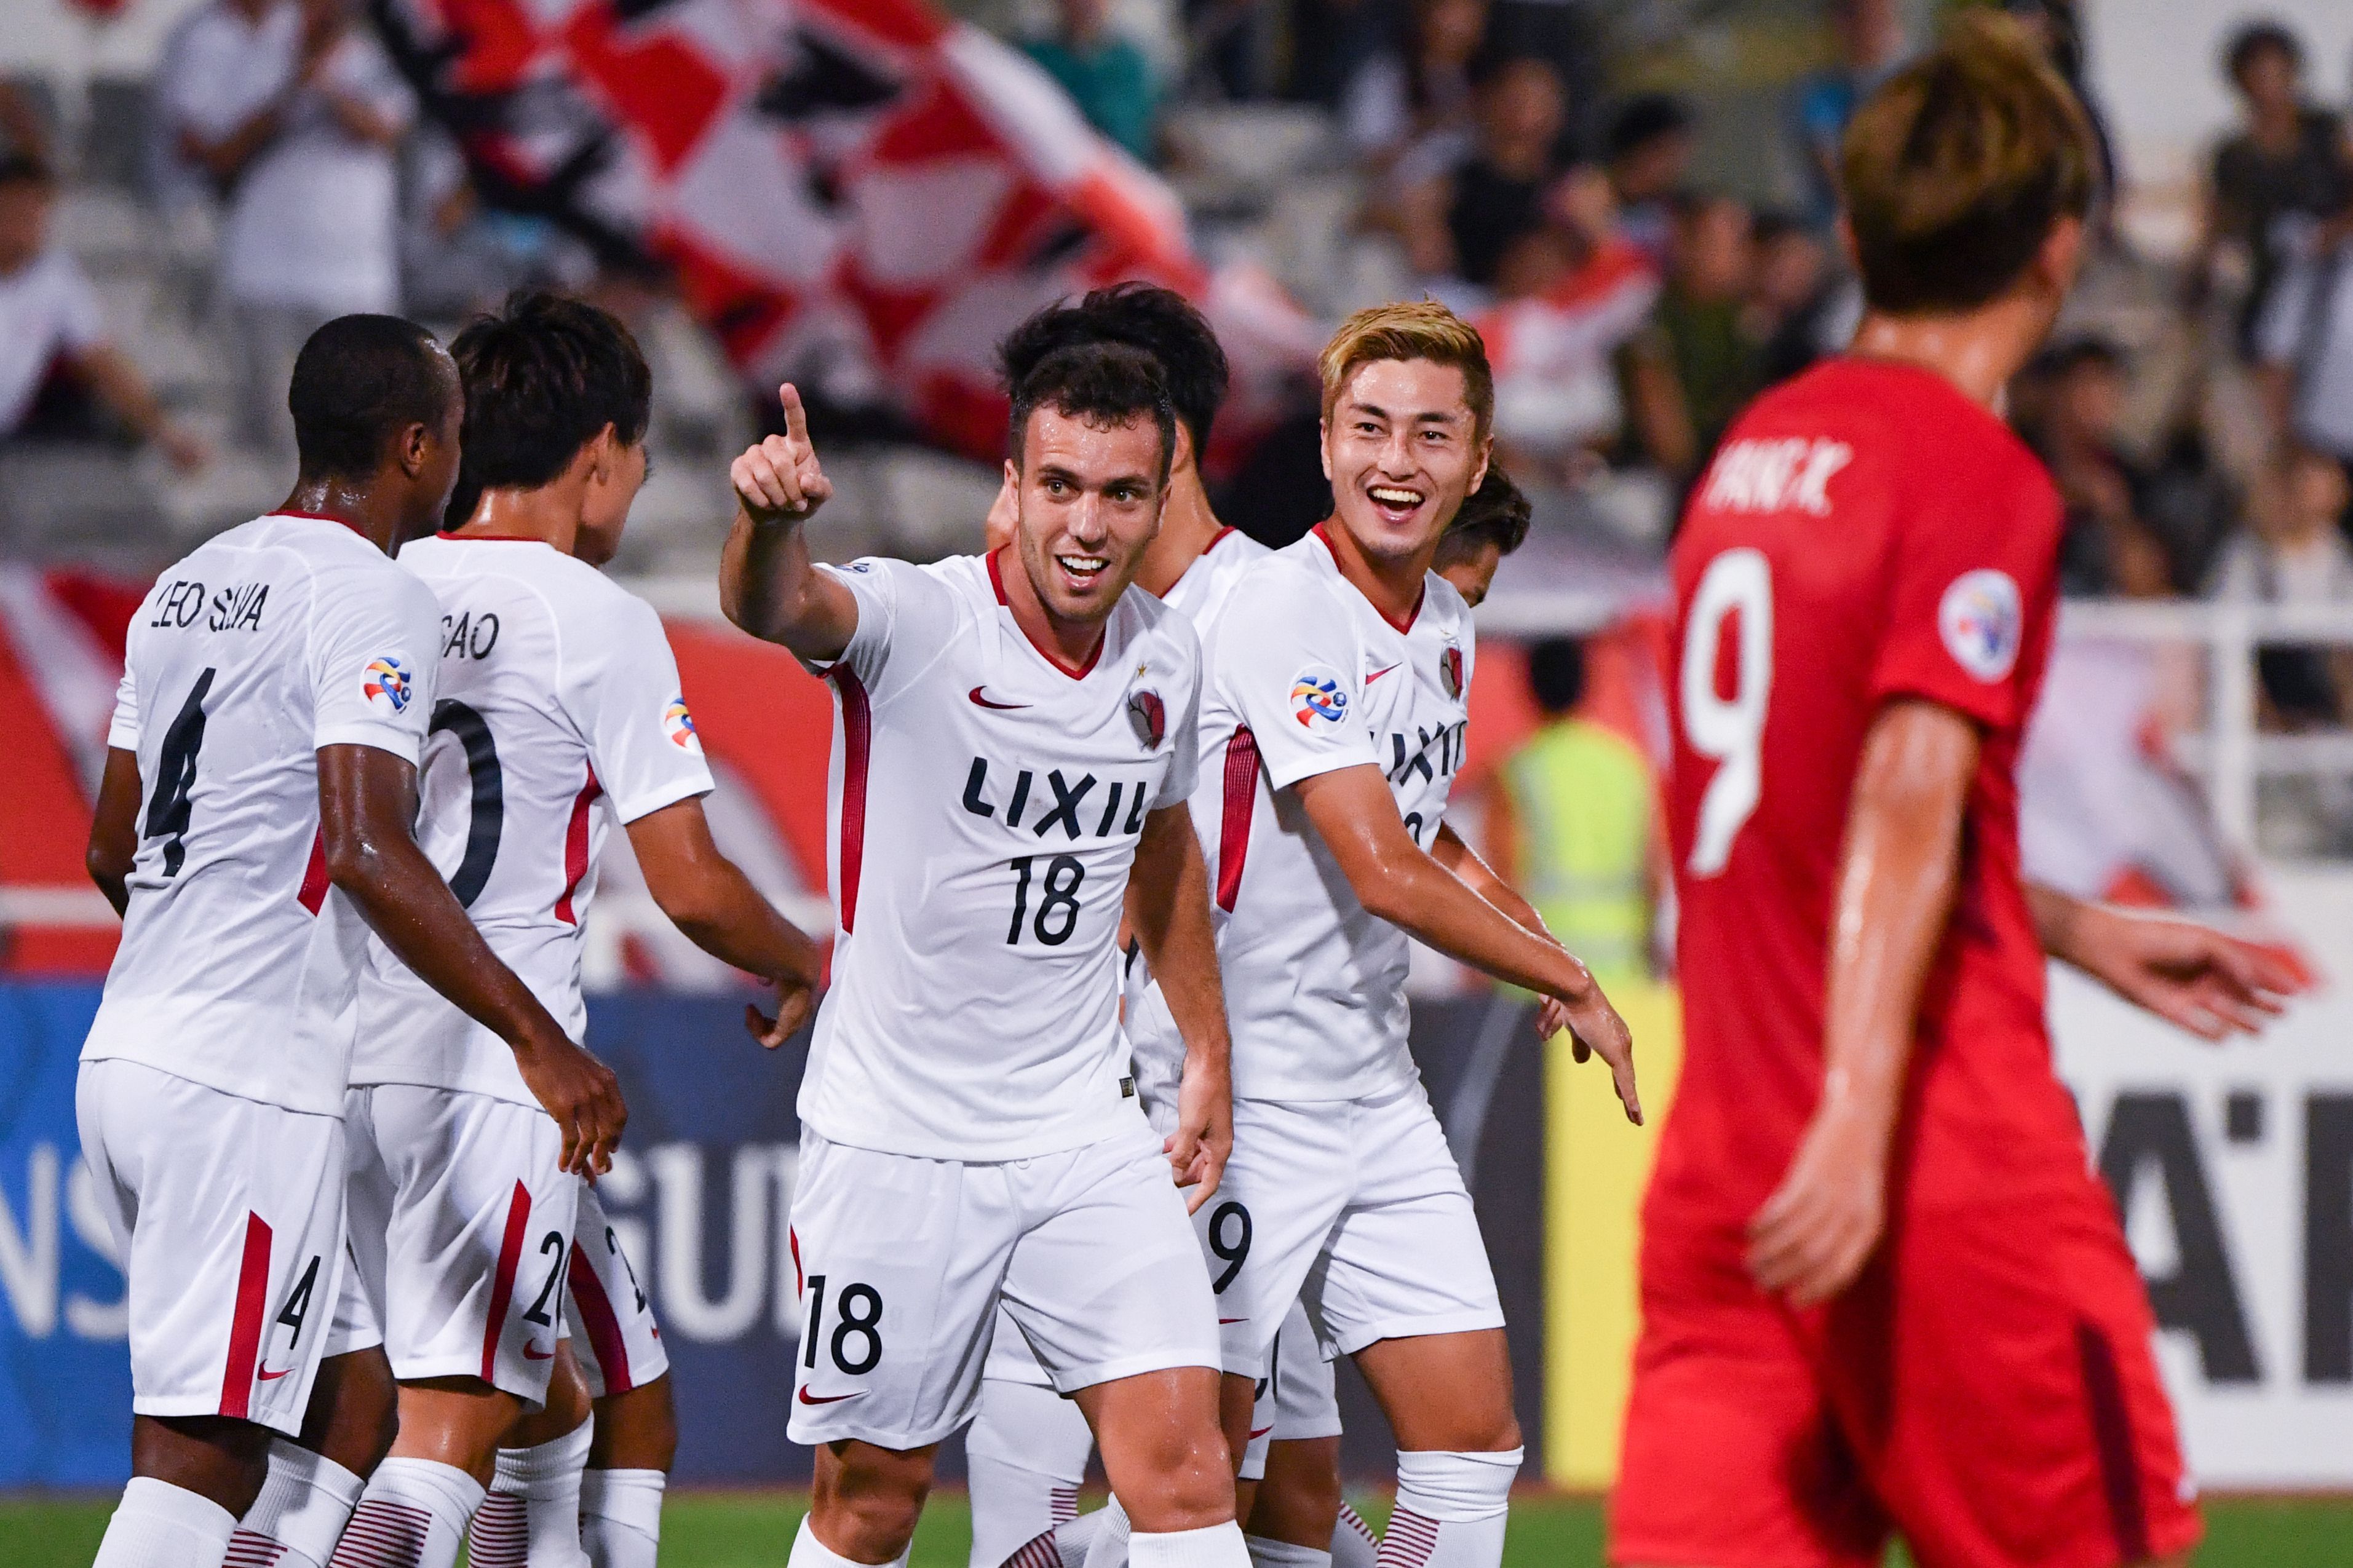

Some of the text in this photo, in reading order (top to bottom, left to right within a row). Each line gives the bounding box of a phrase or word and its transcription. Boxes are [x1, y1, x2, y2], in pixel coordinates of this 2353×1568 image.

[151, 580, 205, 628] LEO
[1681, 546, 1774, 876] 9
[143, 668, 216, 877] 4
[962, 756, 1146, 841] LIXIL
[1007, 856, 1085, 946] 18
[276, 1255, 320, 1350] 4
[804, 1275, 883, 1376] 18
